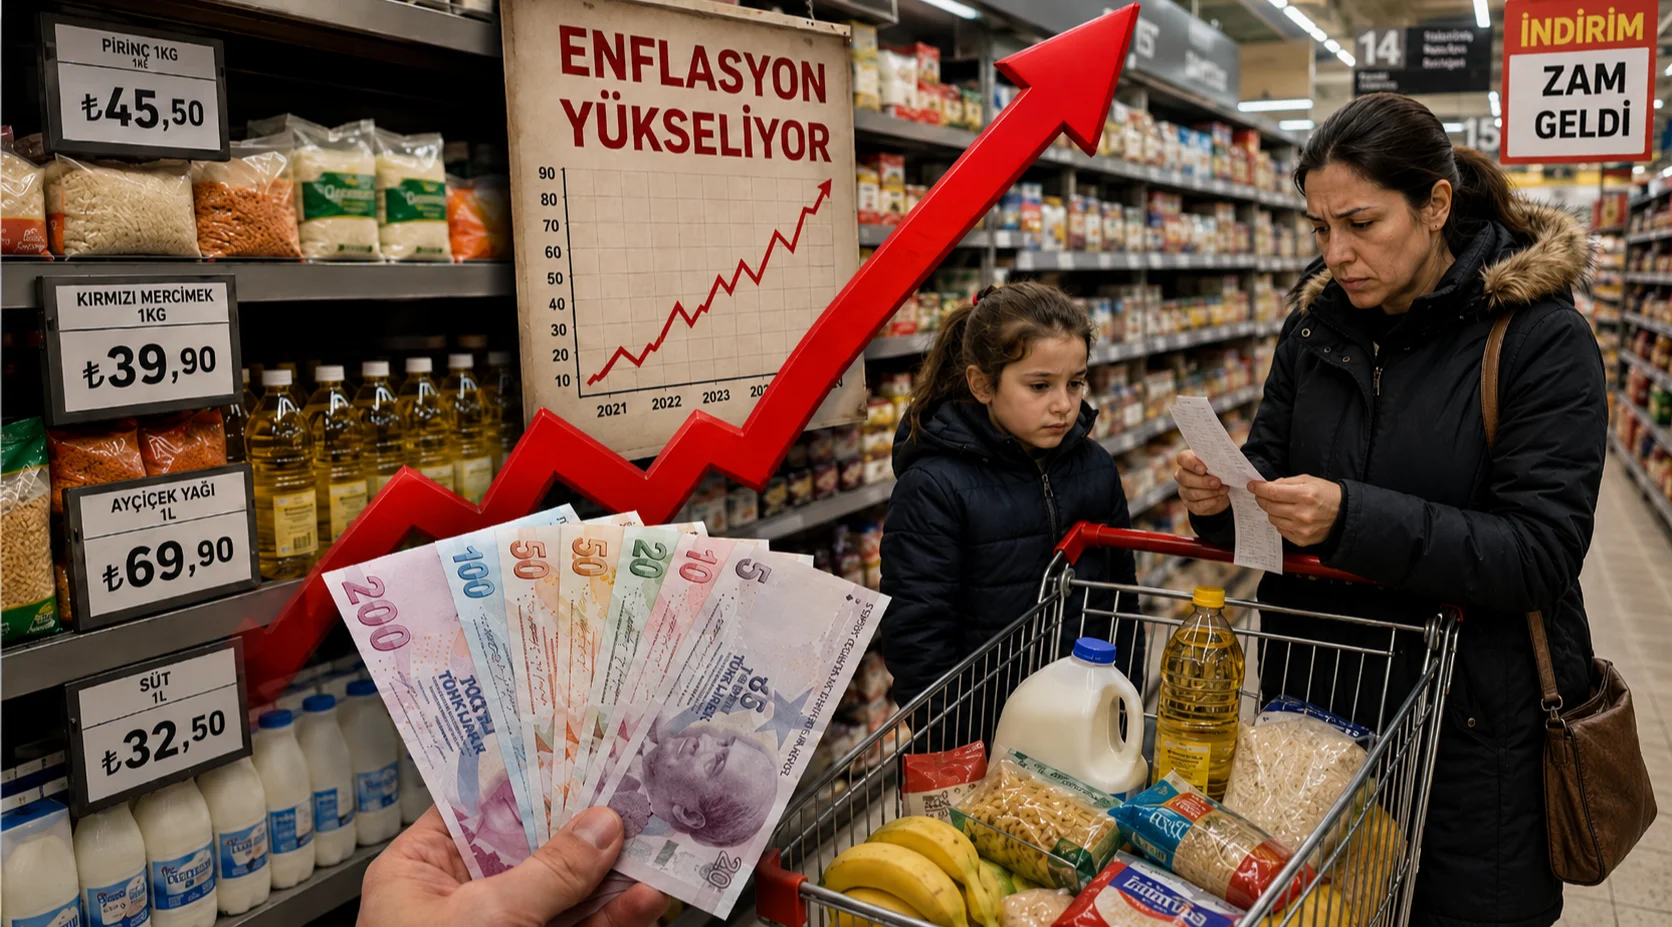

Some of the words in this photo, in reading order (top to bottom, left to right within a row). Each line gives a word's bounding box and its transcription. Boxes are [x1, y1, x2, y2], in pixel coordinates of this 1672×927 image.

[1520, 7, 1644, 48] İNDİRİM
[102, 36, 150, 61] PİRİNÇ
[153, 45, 179, 62] 1KG
[1358, 29, 1401, 66] 14
[559, 24, 827, 104] ENFLASYON
[1542, 62, 1626, 97] ZAM
[559, 89, 832, 163] YÜKSELİYOR
[1534, 100, 1631, 139] GELDİ
[1464, 117, 1501, 151] 15
[538, 167, 556, 180] 90
[540, 193, 558, 206] 80
[543, 219, 560, 232] 70
[544, 246, 562, 259] 60
[547, 272, 564, 285] 50
[77, 290, 136, 307] KIRMIZI
[141, 285, 214, 304] MERCİMEK
[548, 297, 565, 311] 40
[137, 307, 167, 322] 1KG
[550, 323, 567, 337] 30
[552, 348, 569, 362] 20
[555, 374, 570, 387] 10
[597, 402, 627, 418] 2021
[652, 395, 682, 411] 2022
[702, 390, 731, 405] 2023
[110, 489, 177, 514] AYÇİÇEK
[181, 480, 215, 501] YAĞI
[160, 507, 176, 521] 1L
[510, 540, 550, 580] 50
[571, 536, 608, 577] 50
[629, 538, 668, 579] 20
[679, 549, 718, 585] 10
[453, 545, 495, 599] 100
[735, 558, 772, 585] 5
[341, 575, 411, 652] 200
[139, 671, 171, 693] SÜT
[152, 691, 167, 704] 1L
[707, 850, 742, 890] 20
